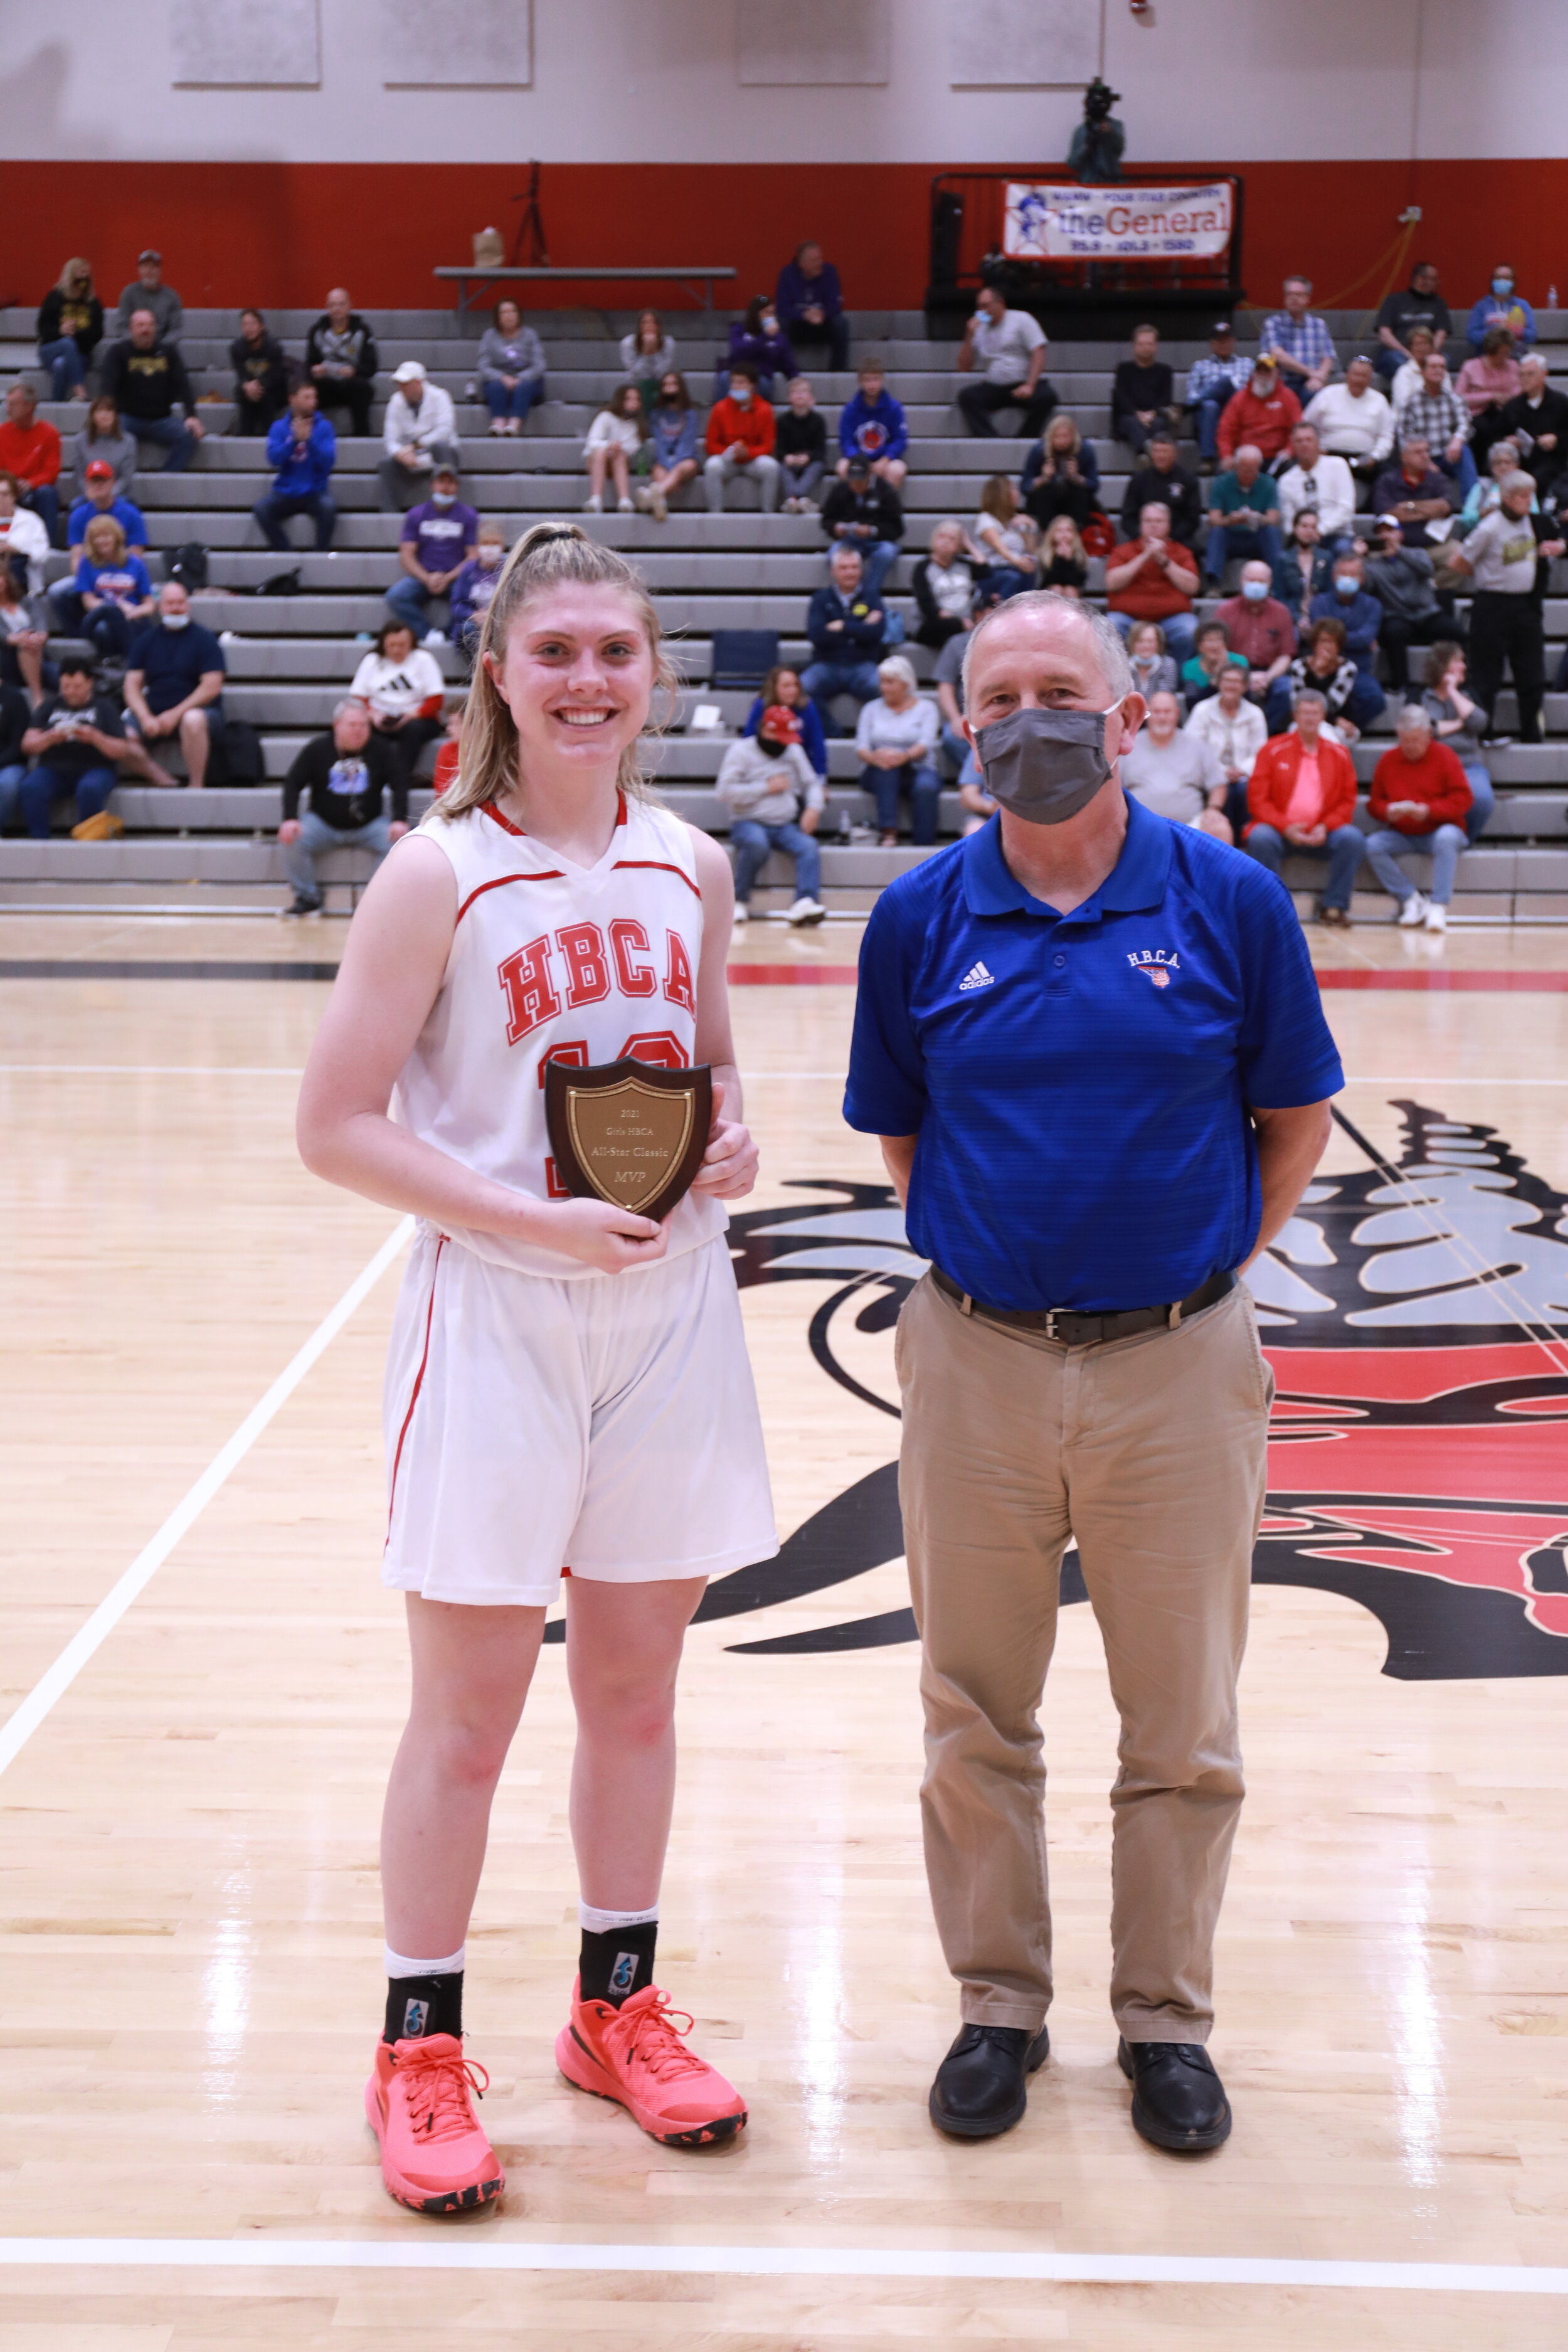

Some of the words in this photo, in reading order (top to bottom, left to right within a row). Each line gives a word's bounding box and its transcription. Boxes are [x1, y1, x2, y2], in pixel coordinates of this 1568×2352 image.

[497, 918, 697, 1047] HBCA
[958, 975, 995, 990] adidas
[606, 1127, 626, 1135] Girls
[627, 1127, 654, 1136] HBCA
[591, 1147, 630, 1157] All-Star
[633, 1147, 669, 1157] Classic
[613, 1172, 647, 1183] MVP
